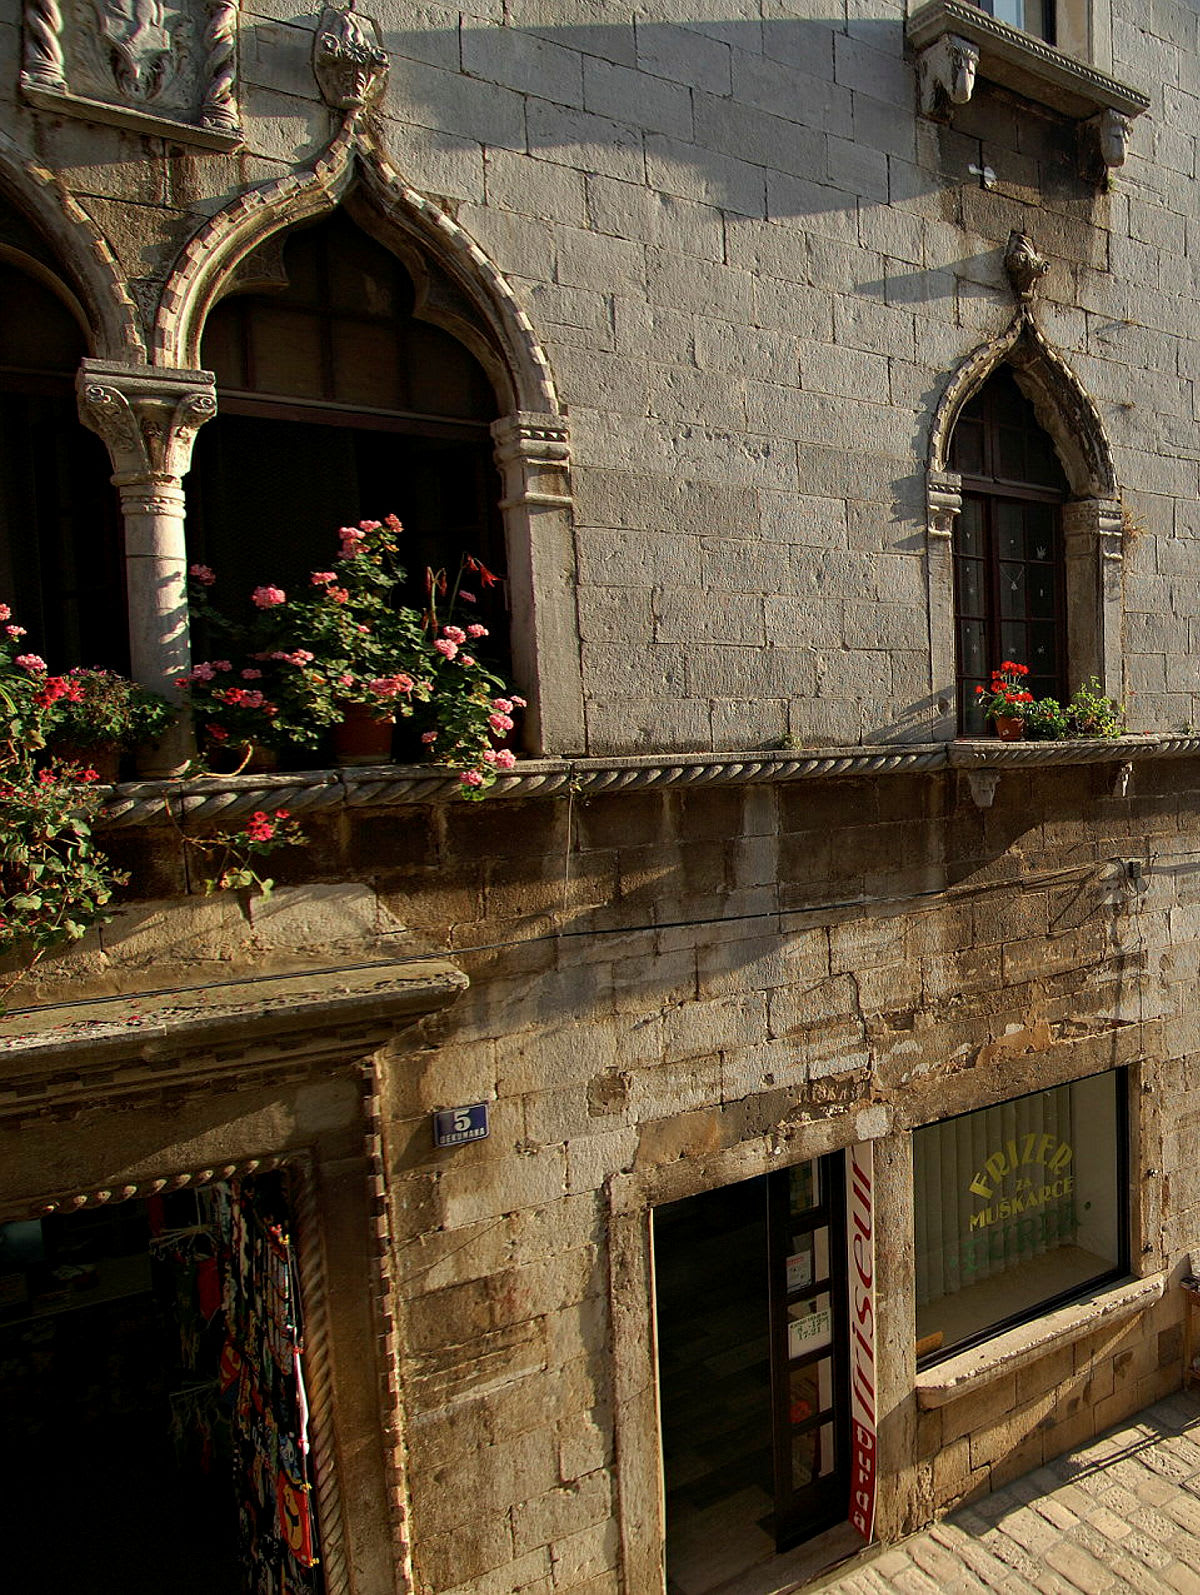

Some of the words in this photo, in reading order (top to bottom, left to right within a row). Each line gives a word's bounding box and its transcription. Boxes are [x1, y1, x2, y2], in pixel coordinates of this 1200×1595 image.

[454, 1109, 471, 1131] 5
[969, 1133, 1073, 1199] FRIZER
[850, 1145, 877, 1428] friseur
